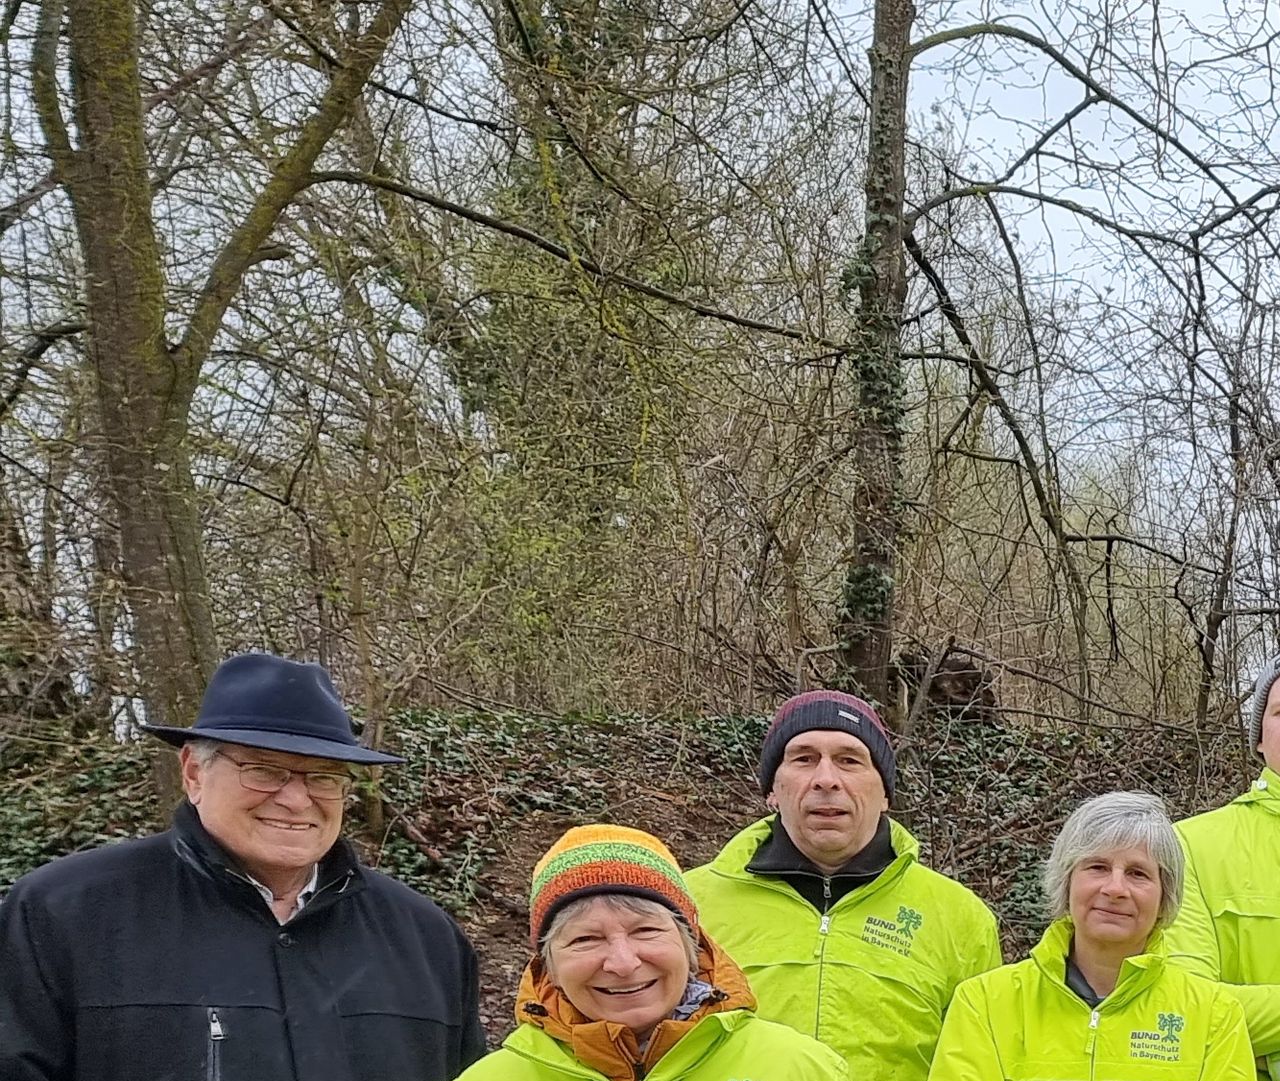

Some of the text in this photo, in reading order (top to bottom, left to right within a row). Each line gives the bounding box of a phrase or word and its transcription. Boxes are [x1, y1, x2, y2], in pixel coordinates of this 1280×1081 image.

[866, 916, 896, 931] BUND
[861, 933, 870, 943] in
[871, 936, 897, 953] Bayern
[863, 925, 912, 949] Naturschutz
[1130, 1031, 1160, 1041] BUND
[1130, 1042, 1179, 1053] Naturschutz
[1130, 1050, 1138, 1058] in
[1139, 1051, 1166, 1062] Bayern
